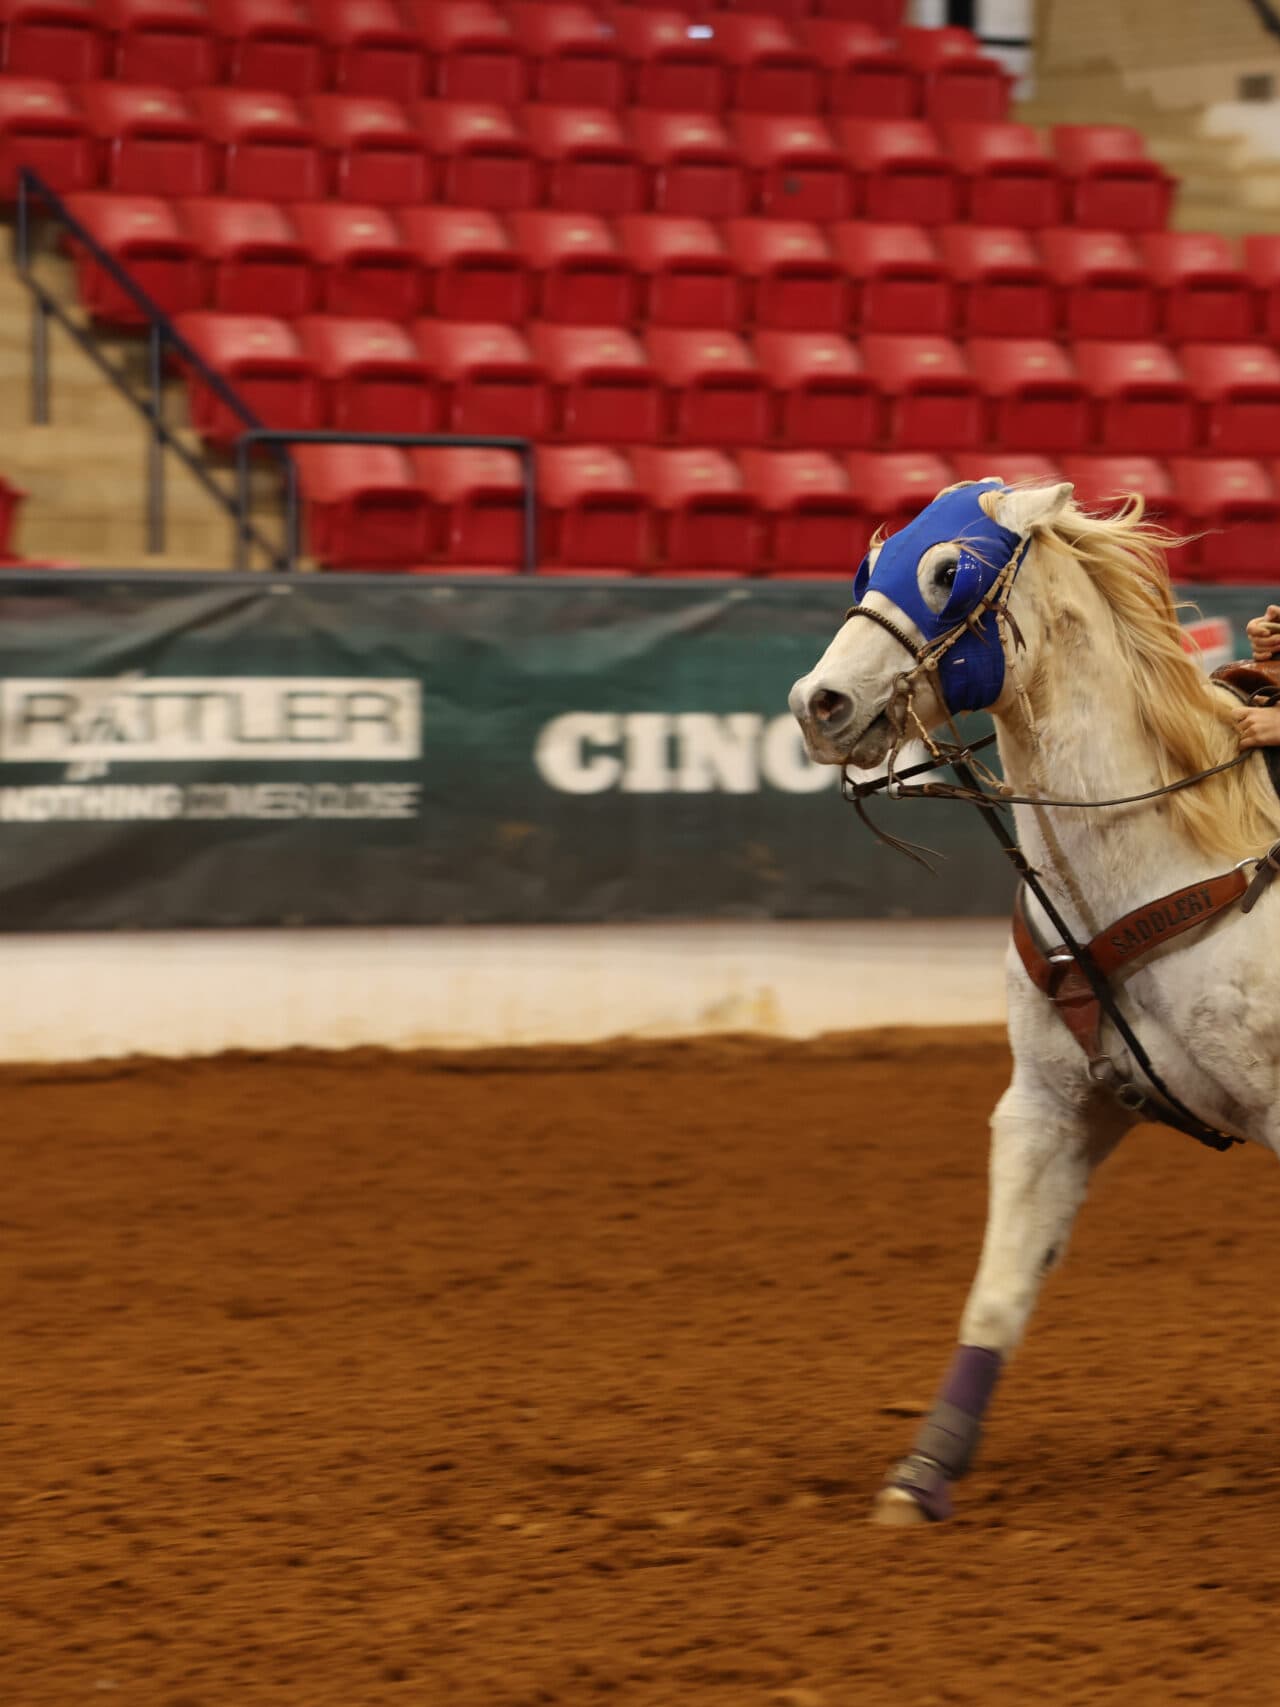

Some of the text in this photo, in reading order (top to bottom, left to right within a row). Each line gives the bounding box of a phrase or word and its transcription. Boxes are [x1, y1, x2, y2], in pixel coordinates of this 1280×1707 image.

[12, 688, 405, 746] RATTLER
[0, 783, 183, 822] NOTHING
[1110, 887, 1214, 955] SADDLERY
